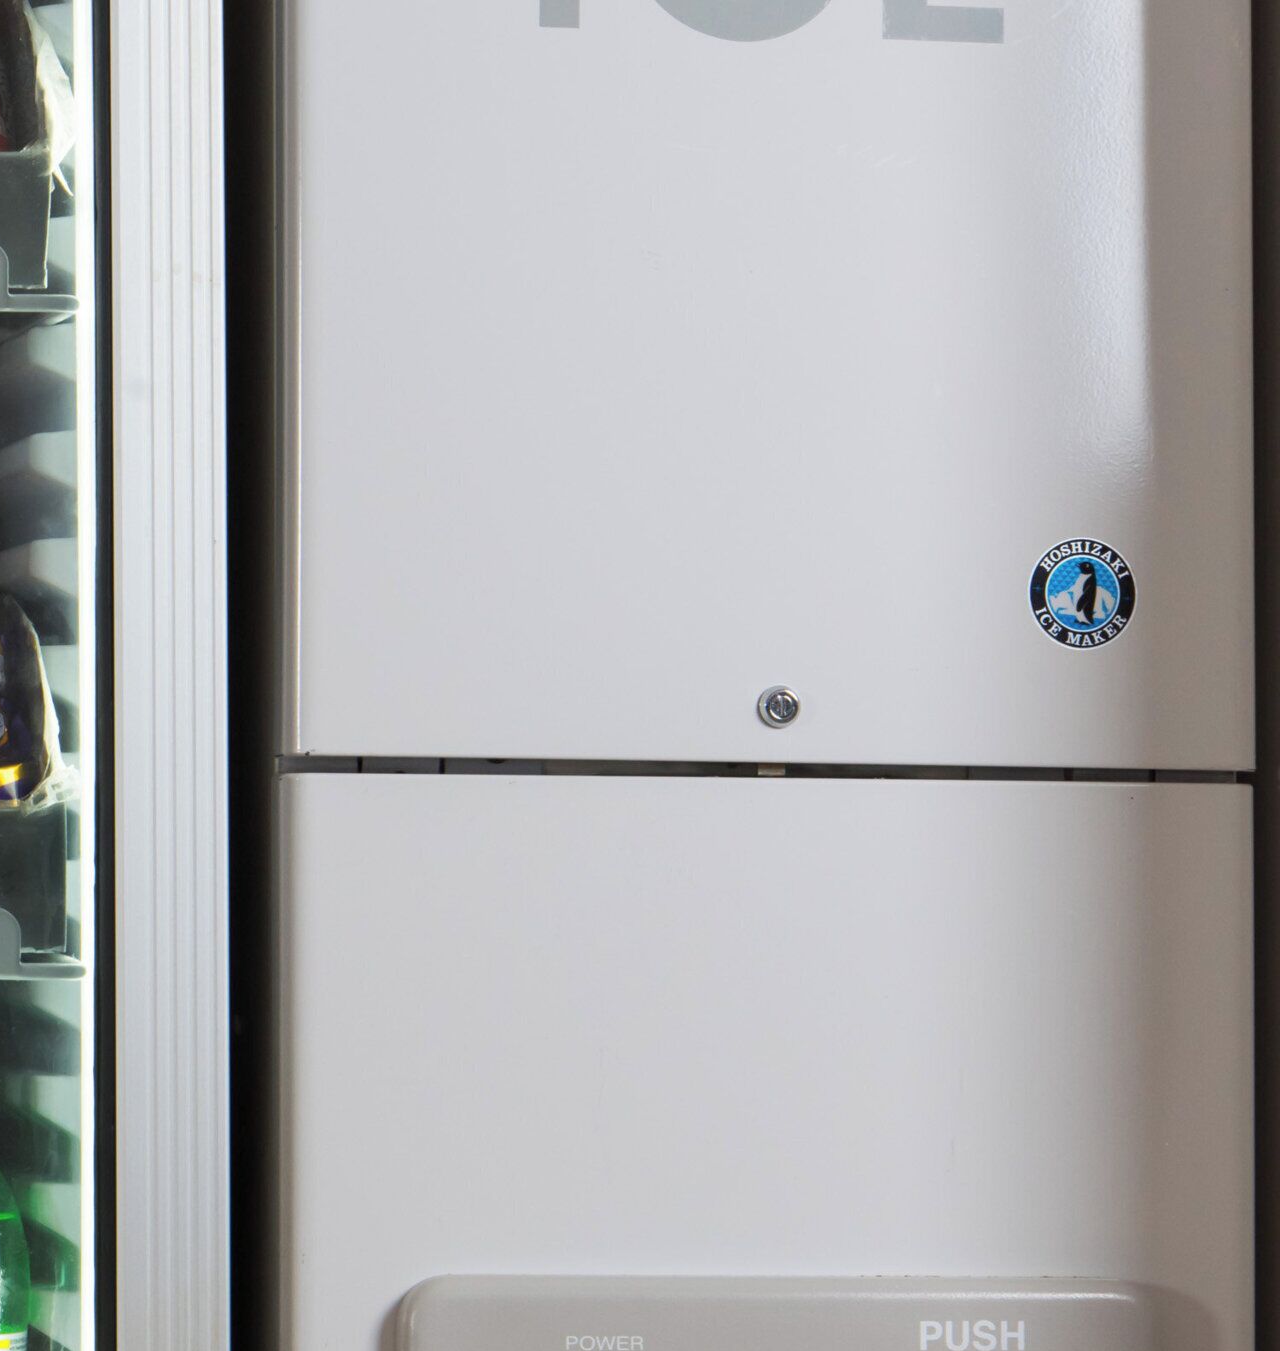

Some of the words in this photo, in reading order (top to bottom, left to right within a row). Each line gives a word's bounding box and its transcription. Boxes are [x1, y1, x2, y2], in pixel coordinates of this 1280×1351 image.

[1040, 541, 1130, 579] HOSHIZAKI
[1035, 607, 1062, 637] ICE
[1066, 614, 1127, 647] MAKER
[565, 1335, 644, 1351] POWER
[919, 1320, 1026, 1351] PUSH
